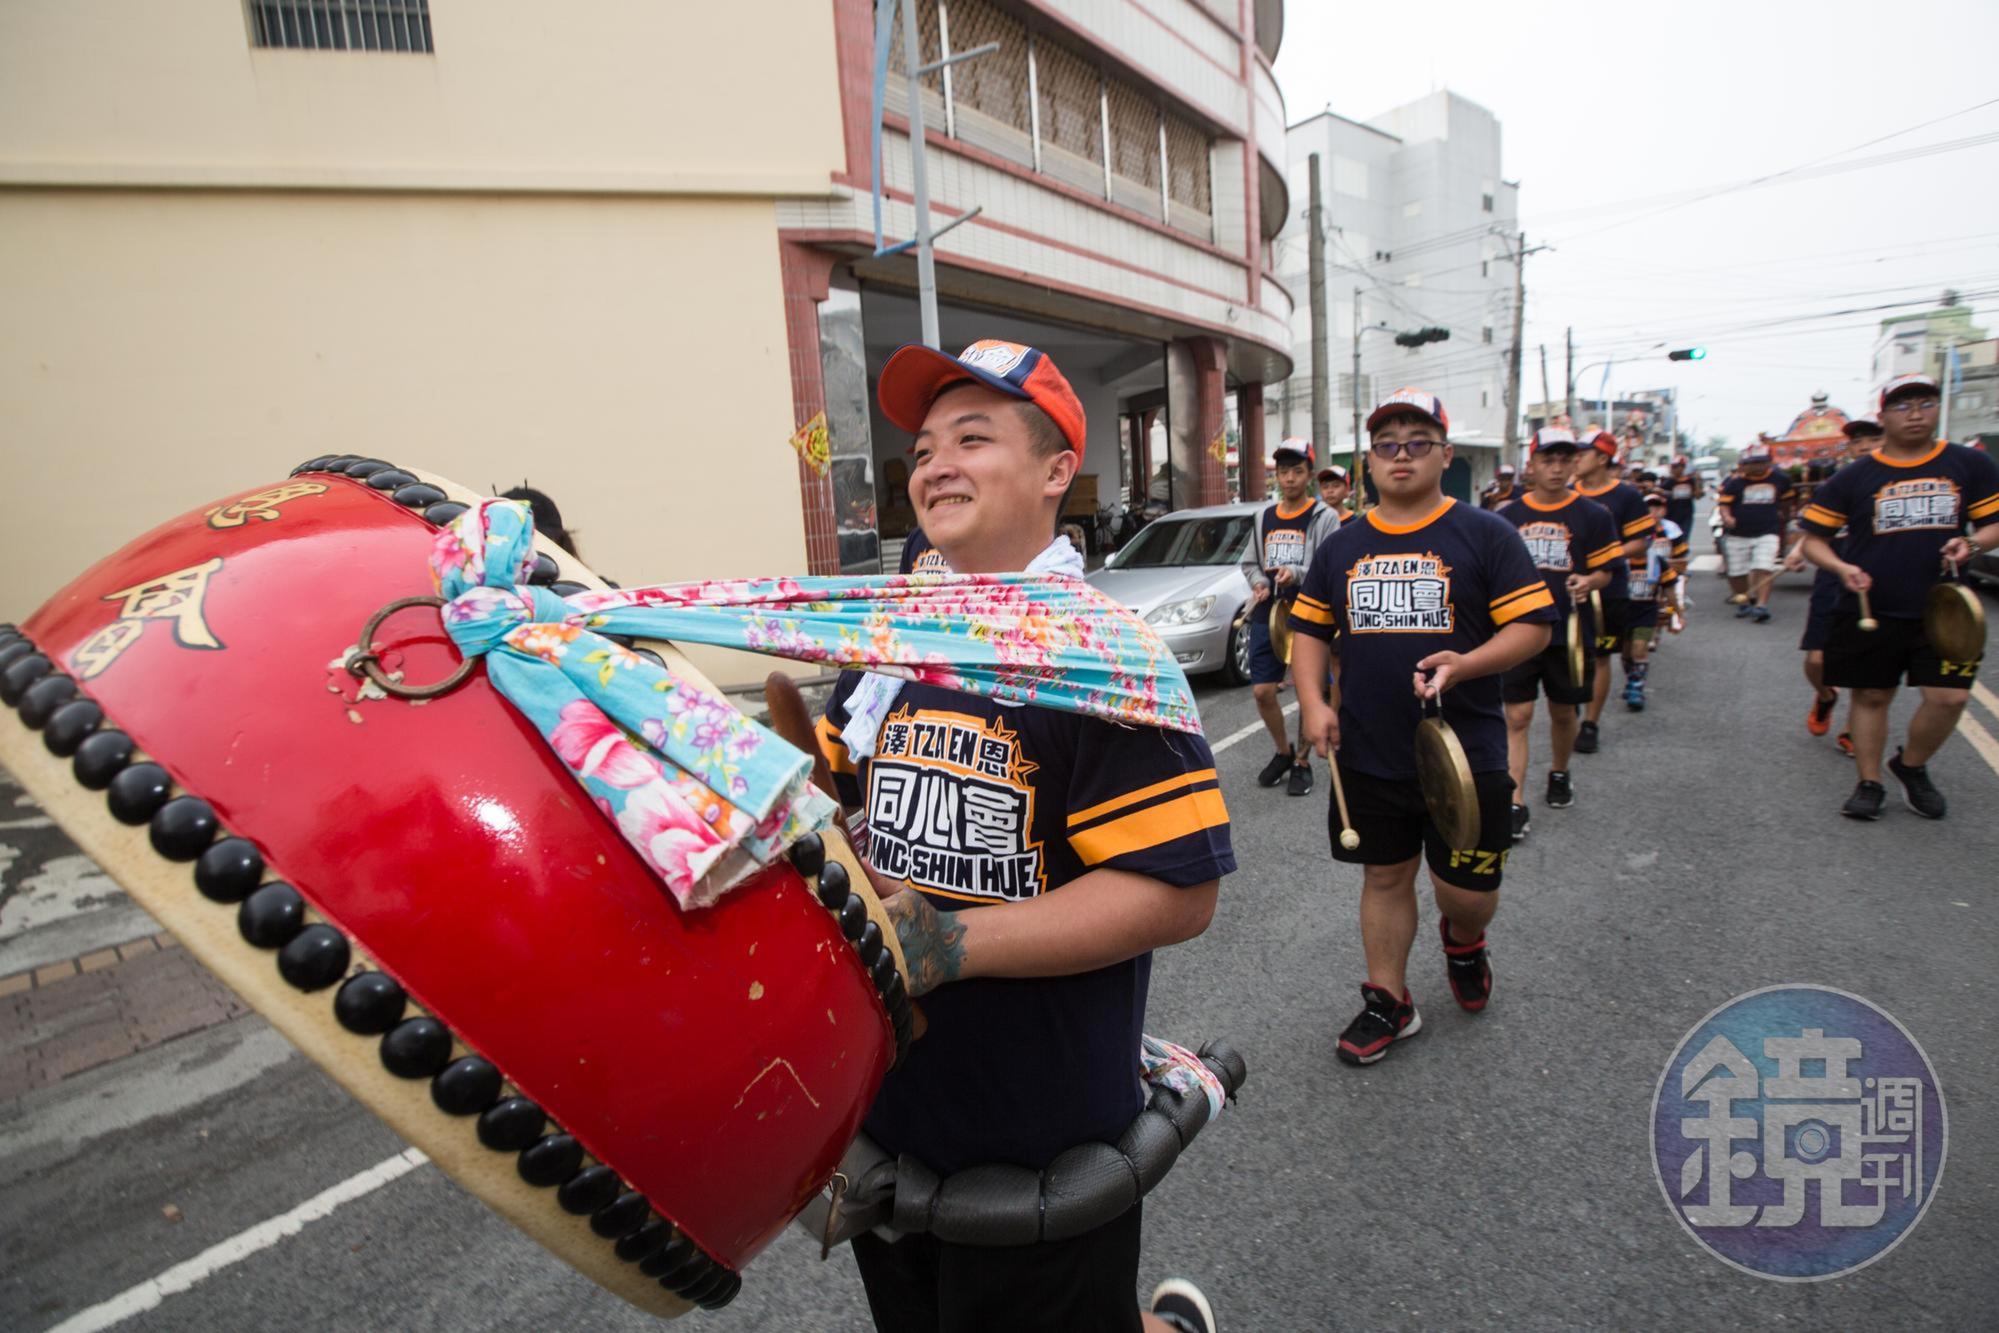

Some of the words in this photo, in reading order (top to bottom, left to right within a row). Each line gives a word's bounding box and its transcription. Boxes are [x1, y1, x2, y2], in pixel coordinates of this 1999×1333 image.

[1349, 611, 1382, 629] TUNG
[1385, 614, 1418, 628] SHIN
[1422, 608, 1449, 628] HUE
[1351, 580, 1443, 612] 同心會
[881, 723, 909, 755] 澤
[976, 737, 1011, 779] 恩
[868, 766, 1021, 856] 同心會
[911, 848, 974, 891] SHIN
[979, 852, 1035, 898] HUE
